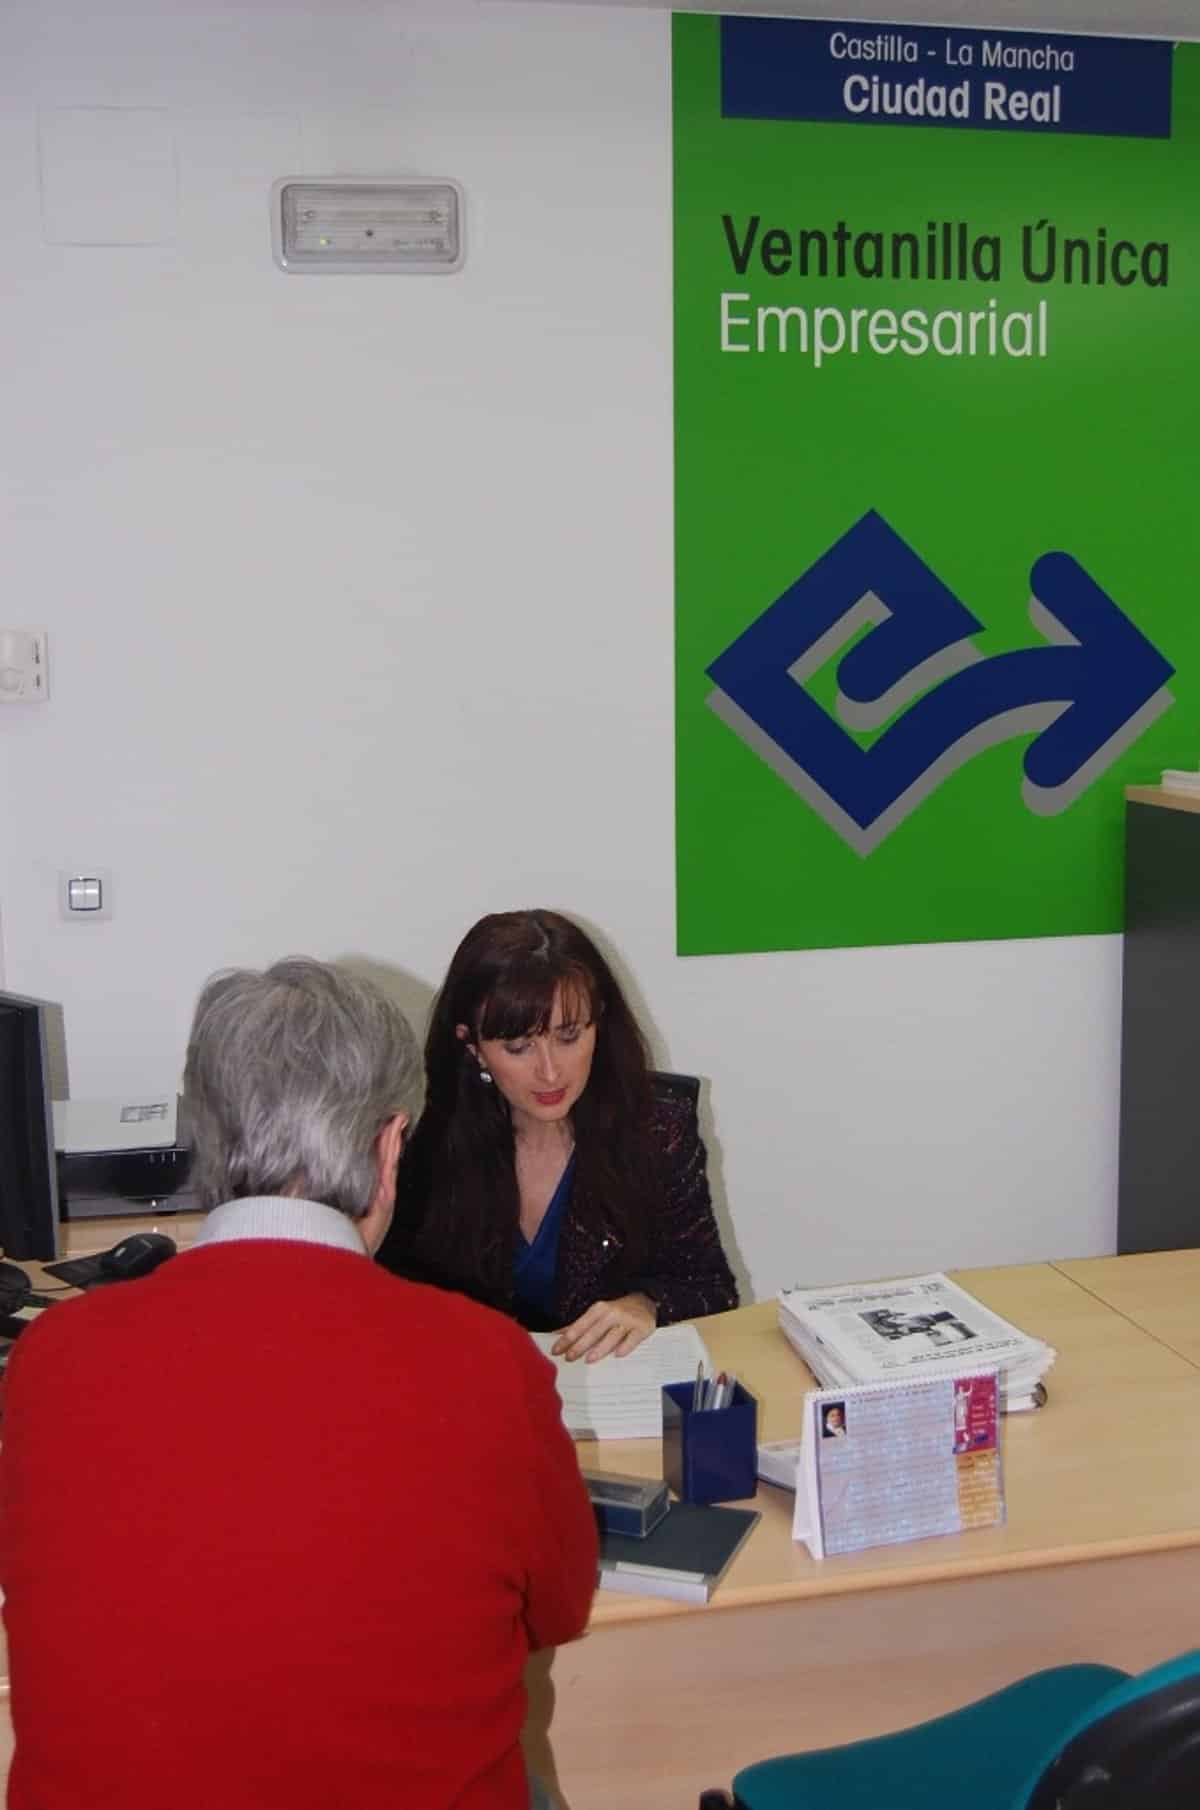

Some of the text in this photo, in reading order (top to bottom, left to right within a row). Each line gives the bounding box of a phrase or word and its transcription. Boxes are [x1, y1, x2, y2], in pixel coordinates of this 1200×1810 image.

[829, 31, 918, 63] Castilla
[945, 38, 973, 66] La
[982, 41, 1075, 71] Mancha
[843, 74, 1061, 123] Ciudad Real
[721, 214, 1170, 288] Ventanilla Única
[720, 292, 1048, 369] Empresarial
